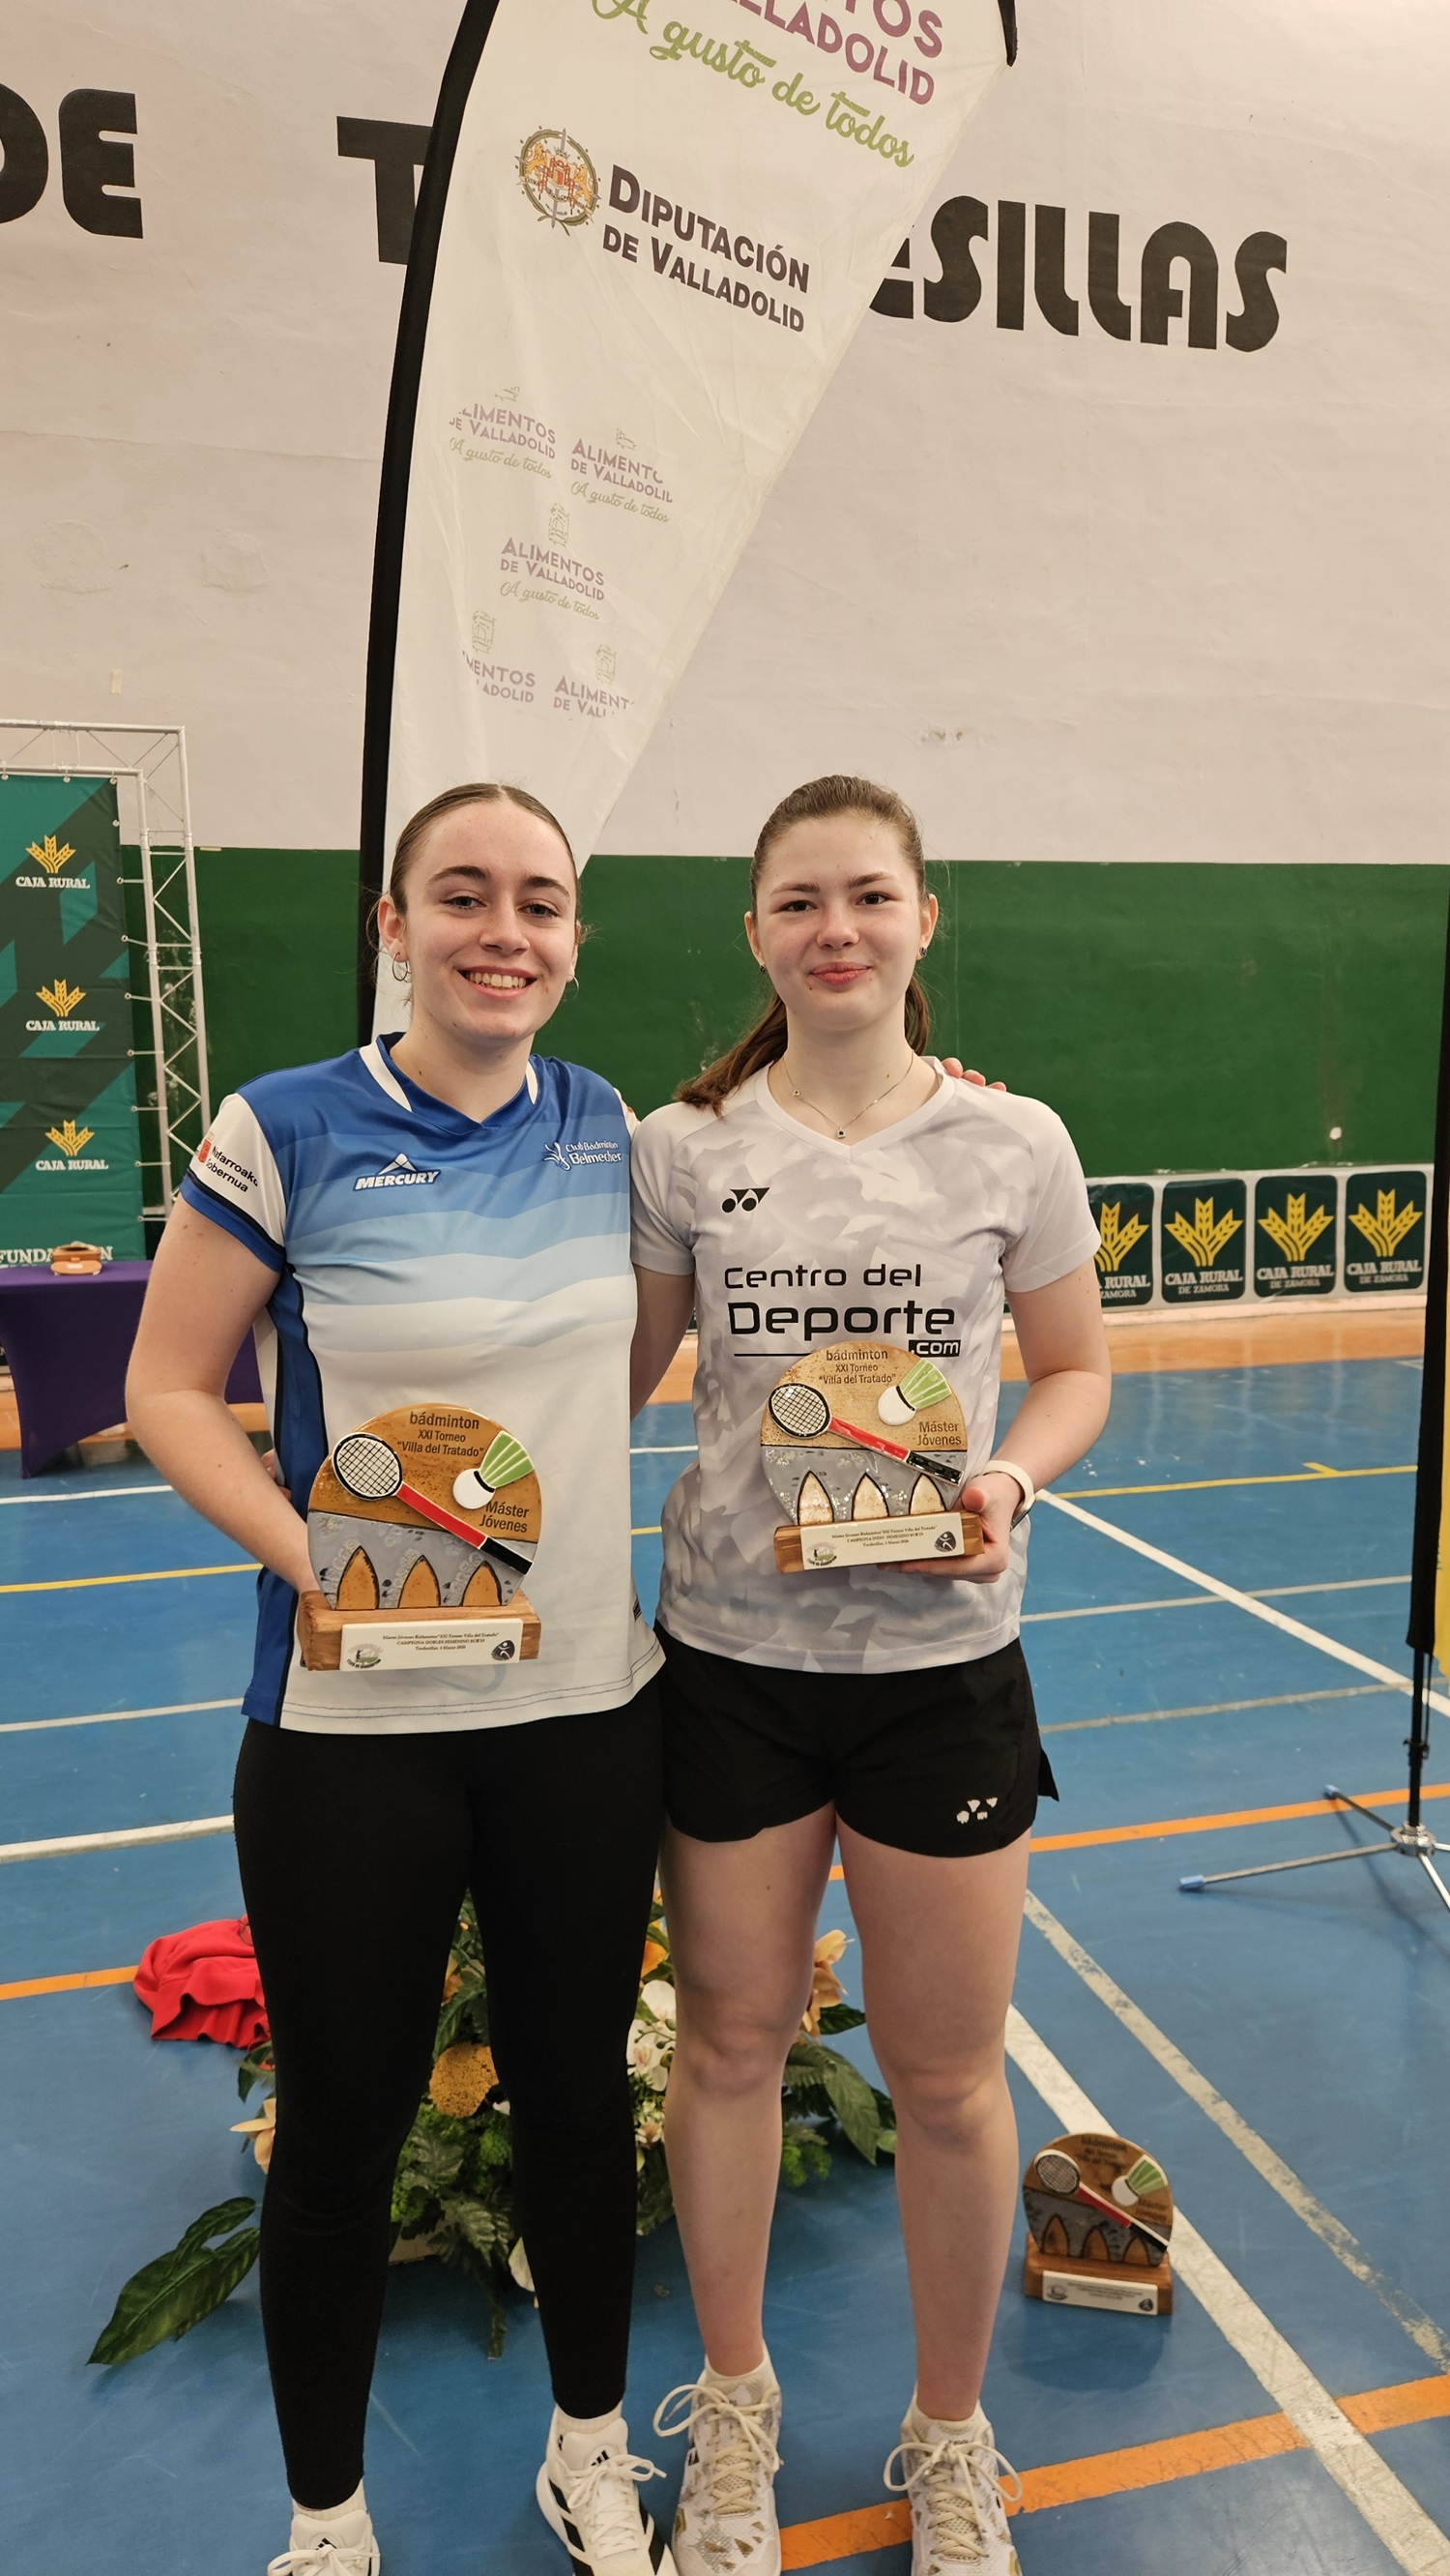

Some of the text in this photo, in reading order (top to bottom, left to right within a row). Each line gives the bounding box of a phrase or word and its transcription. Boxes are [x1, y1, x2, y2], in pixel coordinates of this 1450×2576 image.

[650, 20, 777, 88] gusto
[771, 73, 821, 116] de
[825, 91, 914, 167] todos
[609, 163, 810, 294] DIPUTACIÓN
[603, 223, 804, 333] DE VALLADOLID
[458, 403, 556, 445] LIMENTOS
[469, 419, 556, 459] VALLADOLID
[450, 437, 552, 479] A gusto de todos
[570, 458, 588, 475] DE
[570, 482, 670, 523] A gusto de todos
[501, 537, 604, 586] ALIMENTOS
[500, 559, 605, 600] DE VALLADOLID
[500, 580, 599, 620] A gusto de todos
[553, 697, 570, 711] DE
[15, 876, 91, 889] CAJA RURAL
[25, 1020, 100, 1032] CAJA RURAL
[35, 1159, 109, 1171] CAJA RURAL
[354, 1171, 439, 1190] MERCURY
[1257, 1265, 1335, 1280] CAJA RURAL
[1347, 1260, 1422, 1275] CAJA RURAL
[725, 1264, 921, 1288] Centro del
[1104, 1274, 1151, 1289] RURAL
[1165, 1270, 1243, 1285] CAJA RURAL
[1270, 1278, 1320, 1289] DE ZAMORA
[1193, 1284, 1230, 1294] ZAMORA
[728, 1301, 955, 1341] Deporte
[826, 1348, 888, 1361] bádminton
[911, 1340, 960, 1356] .com
[835, 1363, 879, 1373] XXI Torneo
[843, 1373, 858, 1385] del
[409, 1411, 479, 1429] bádminton
[919, 1420, 960, 1434] Máster
[418, 1429, 466, 1443] XXI Torneo
[917, 1433, 962, 1447] Jóvenes
[424, 1443, 441, 1454] del
[485, 1500, 530, 1518] Máster
[478, 1514, 528, 1534] Jóvenes
